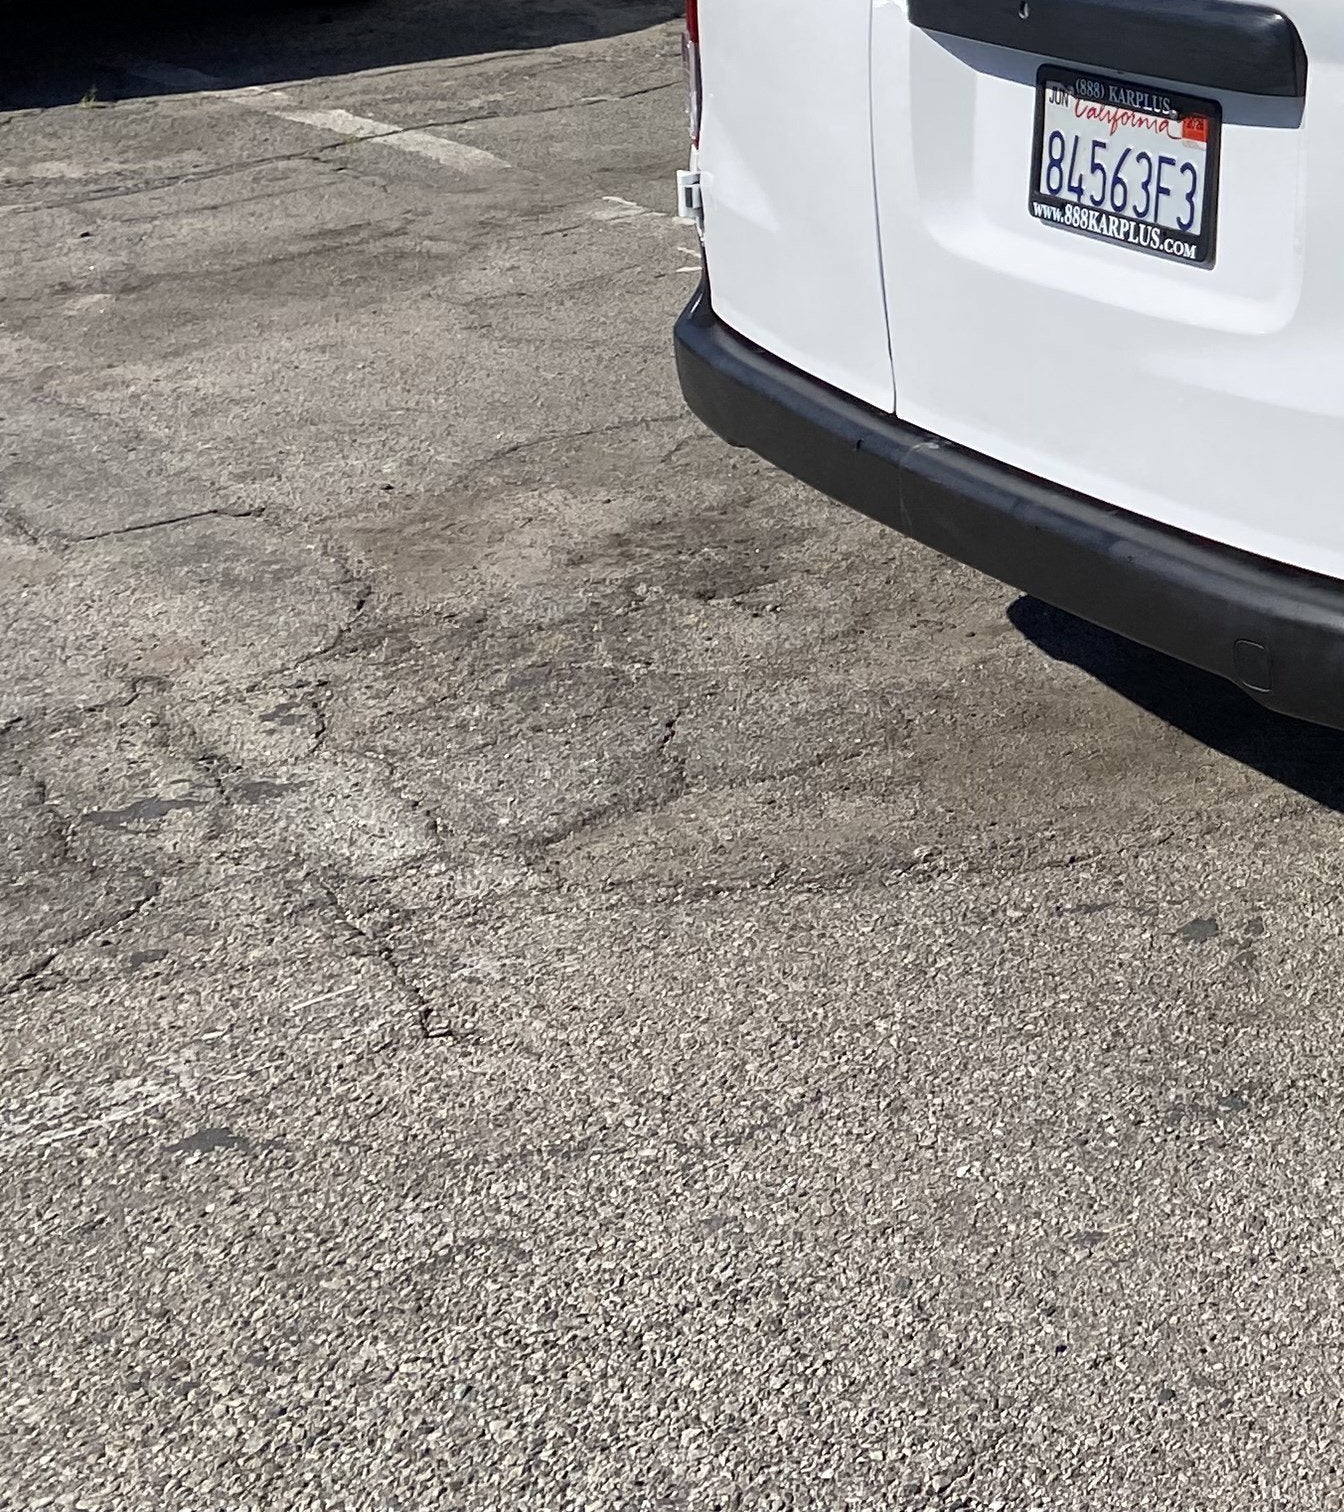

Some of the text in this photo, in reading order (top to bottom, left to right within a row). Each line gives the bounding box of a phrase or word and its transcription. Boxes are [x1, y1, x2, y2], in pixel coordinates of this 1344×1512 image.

[1049, 86, 1069, 108] JUN
[1075, 78, 1171, 115] (888) KARPLUS
[1074, 97, 1182, 139] California
[1046, 130, 1198, 232] 84563F3
